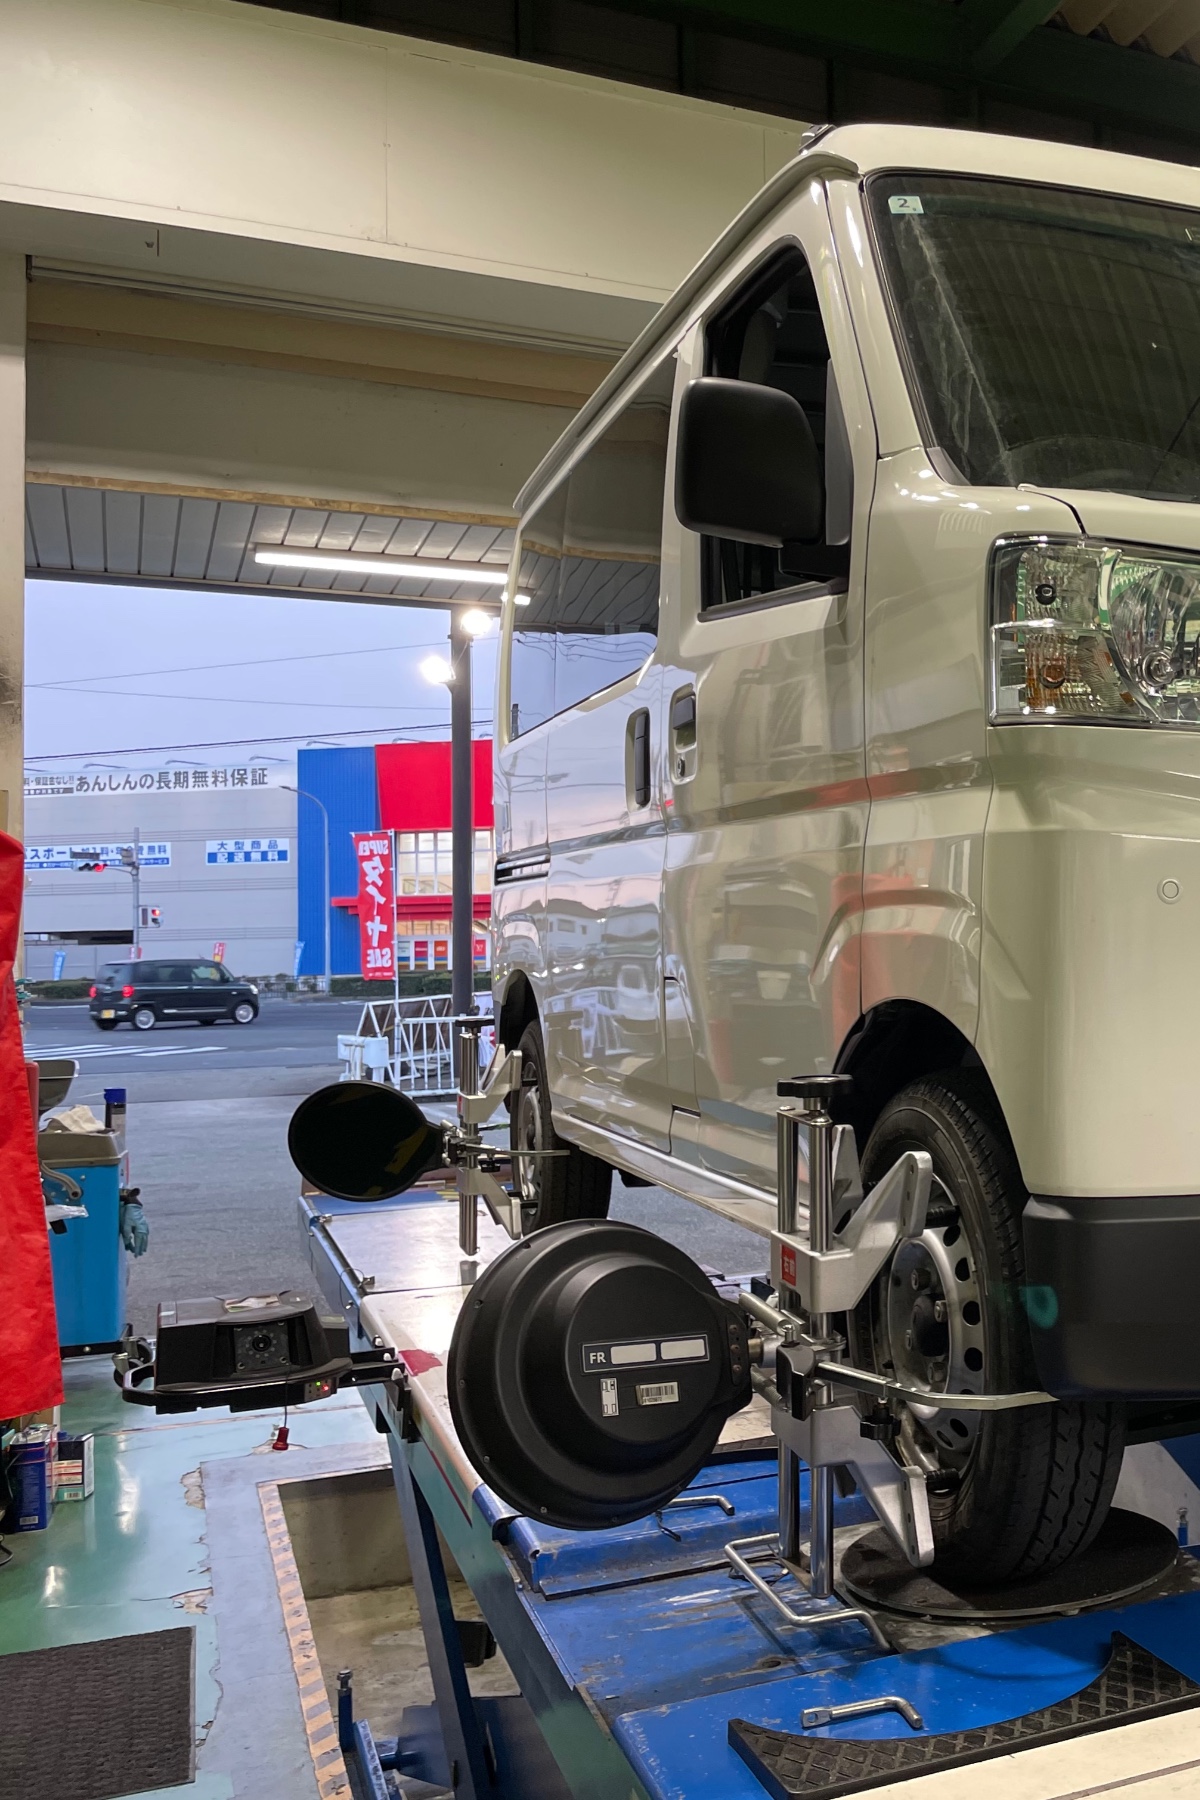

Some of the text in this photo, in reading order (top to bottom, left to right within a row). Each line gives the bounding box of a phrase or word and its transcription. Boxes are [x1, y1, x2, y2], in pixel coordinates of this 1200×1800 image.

[76, 767, 268, 792] あんしんの長期無料保証
[217, 839, 278, 851] 大型商品
[590, 1352, 606, 1364] FR
